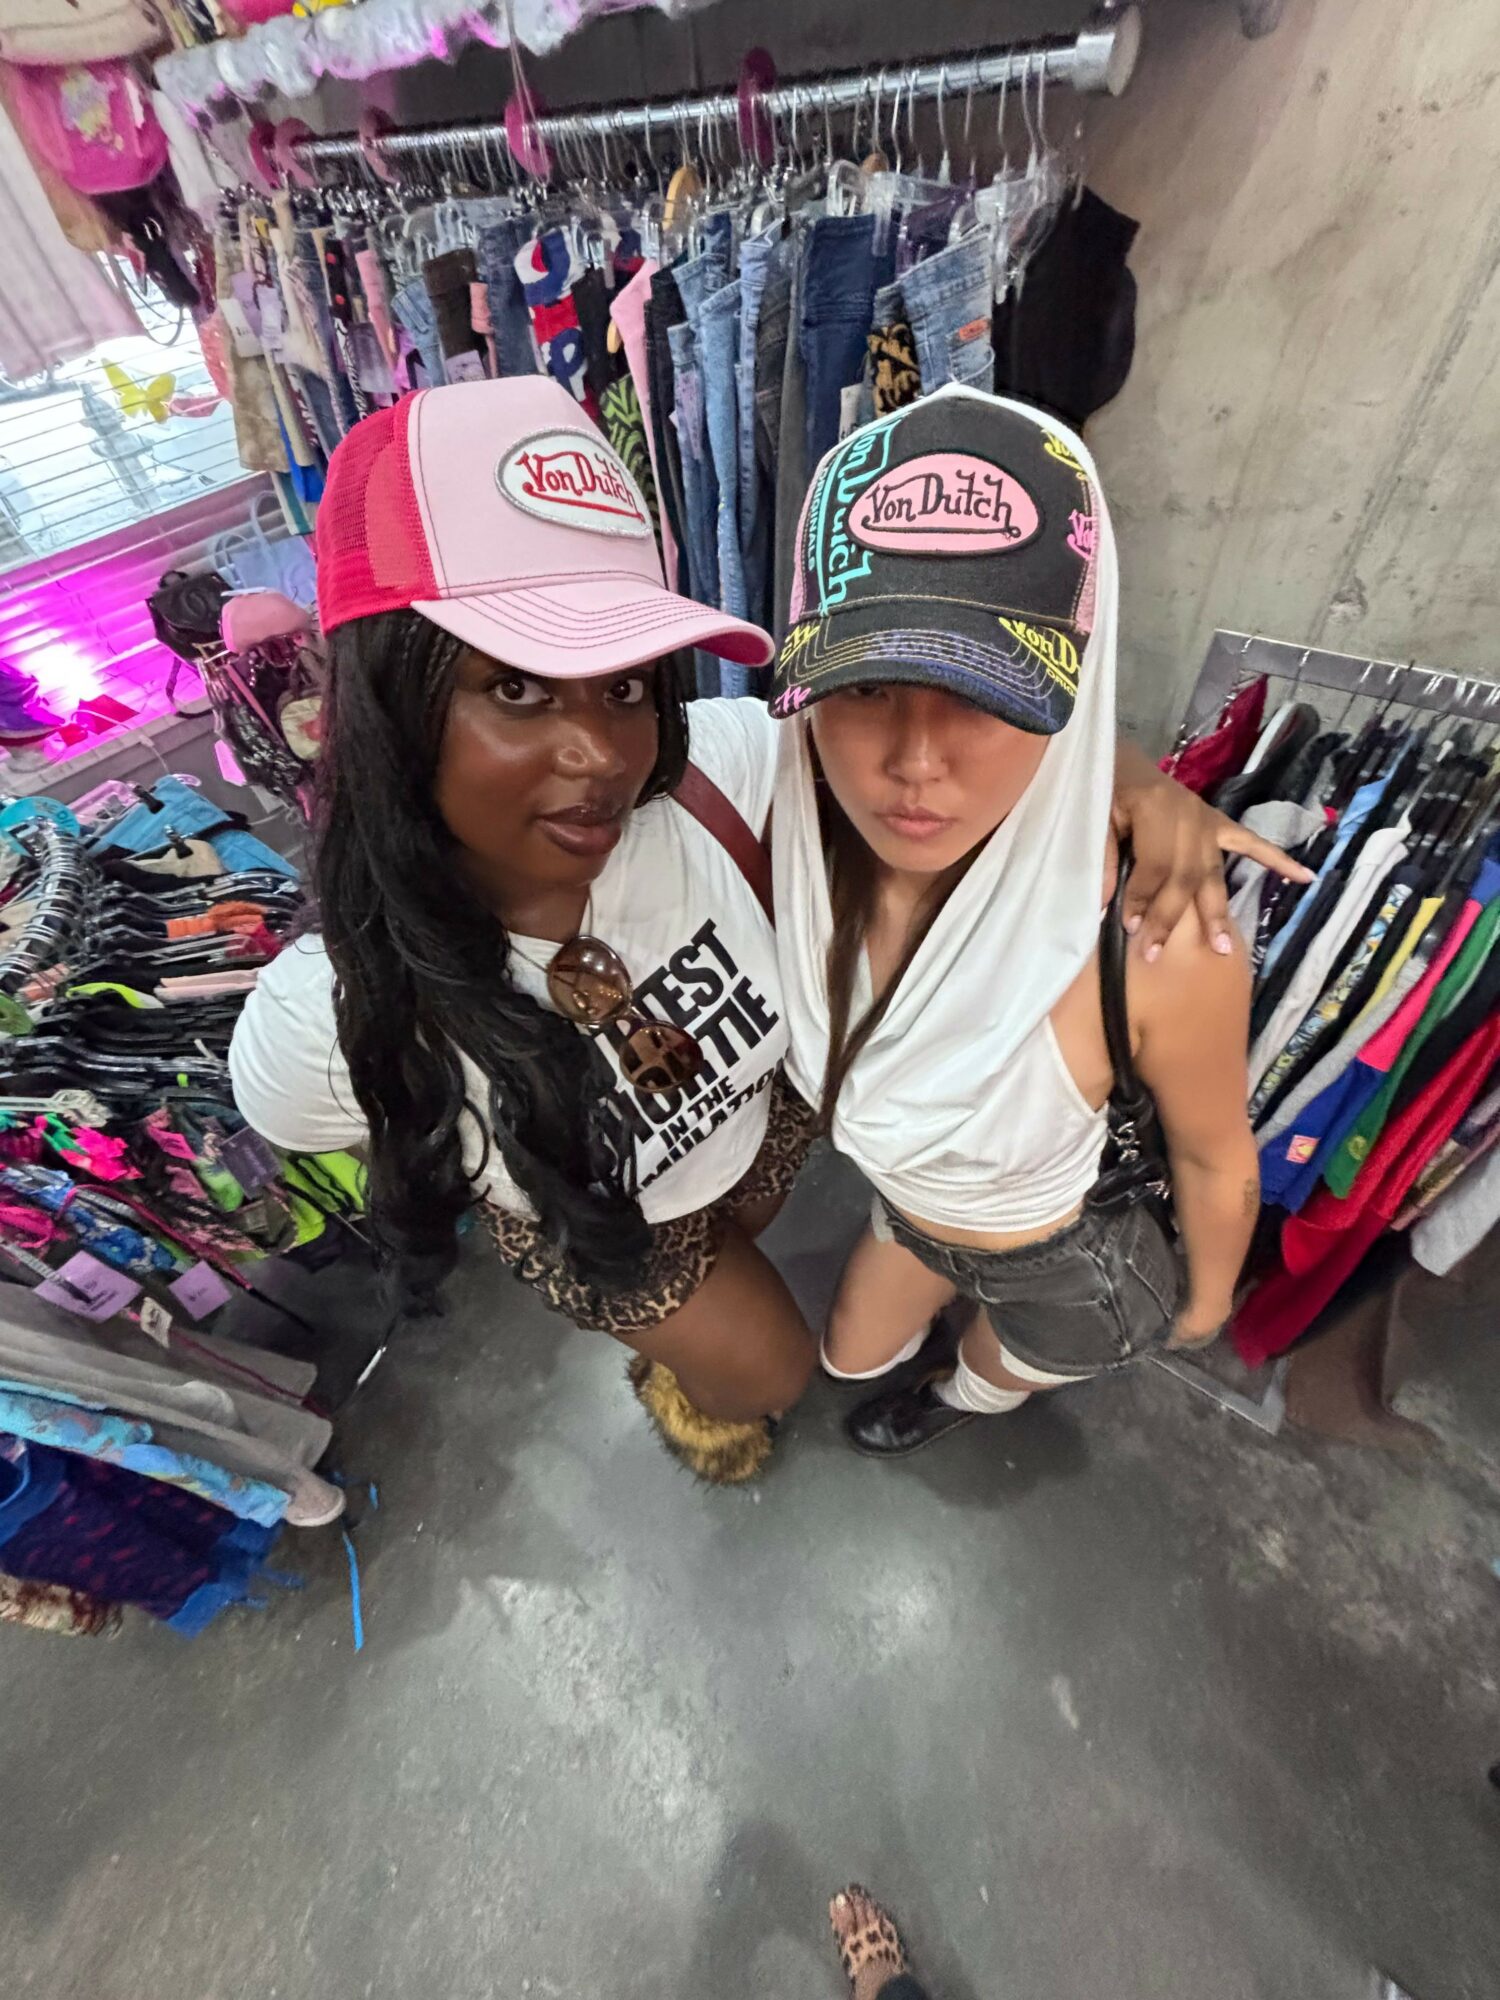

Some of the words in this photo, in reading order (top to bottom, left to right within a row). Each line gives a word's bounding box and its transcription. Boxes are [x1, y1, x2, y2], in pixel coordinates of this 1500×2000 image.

[515, 451, 582, 496] Von
[576, 451, 643, 520] Dutch
[865, 483, 915, 524] Von
[918, 470, 1016, 536] Dutch
[1012, 620, 1059, 666] Von
[659, 1122, 689, 1150] IN
[687, 1076, 736, 1121] THE
